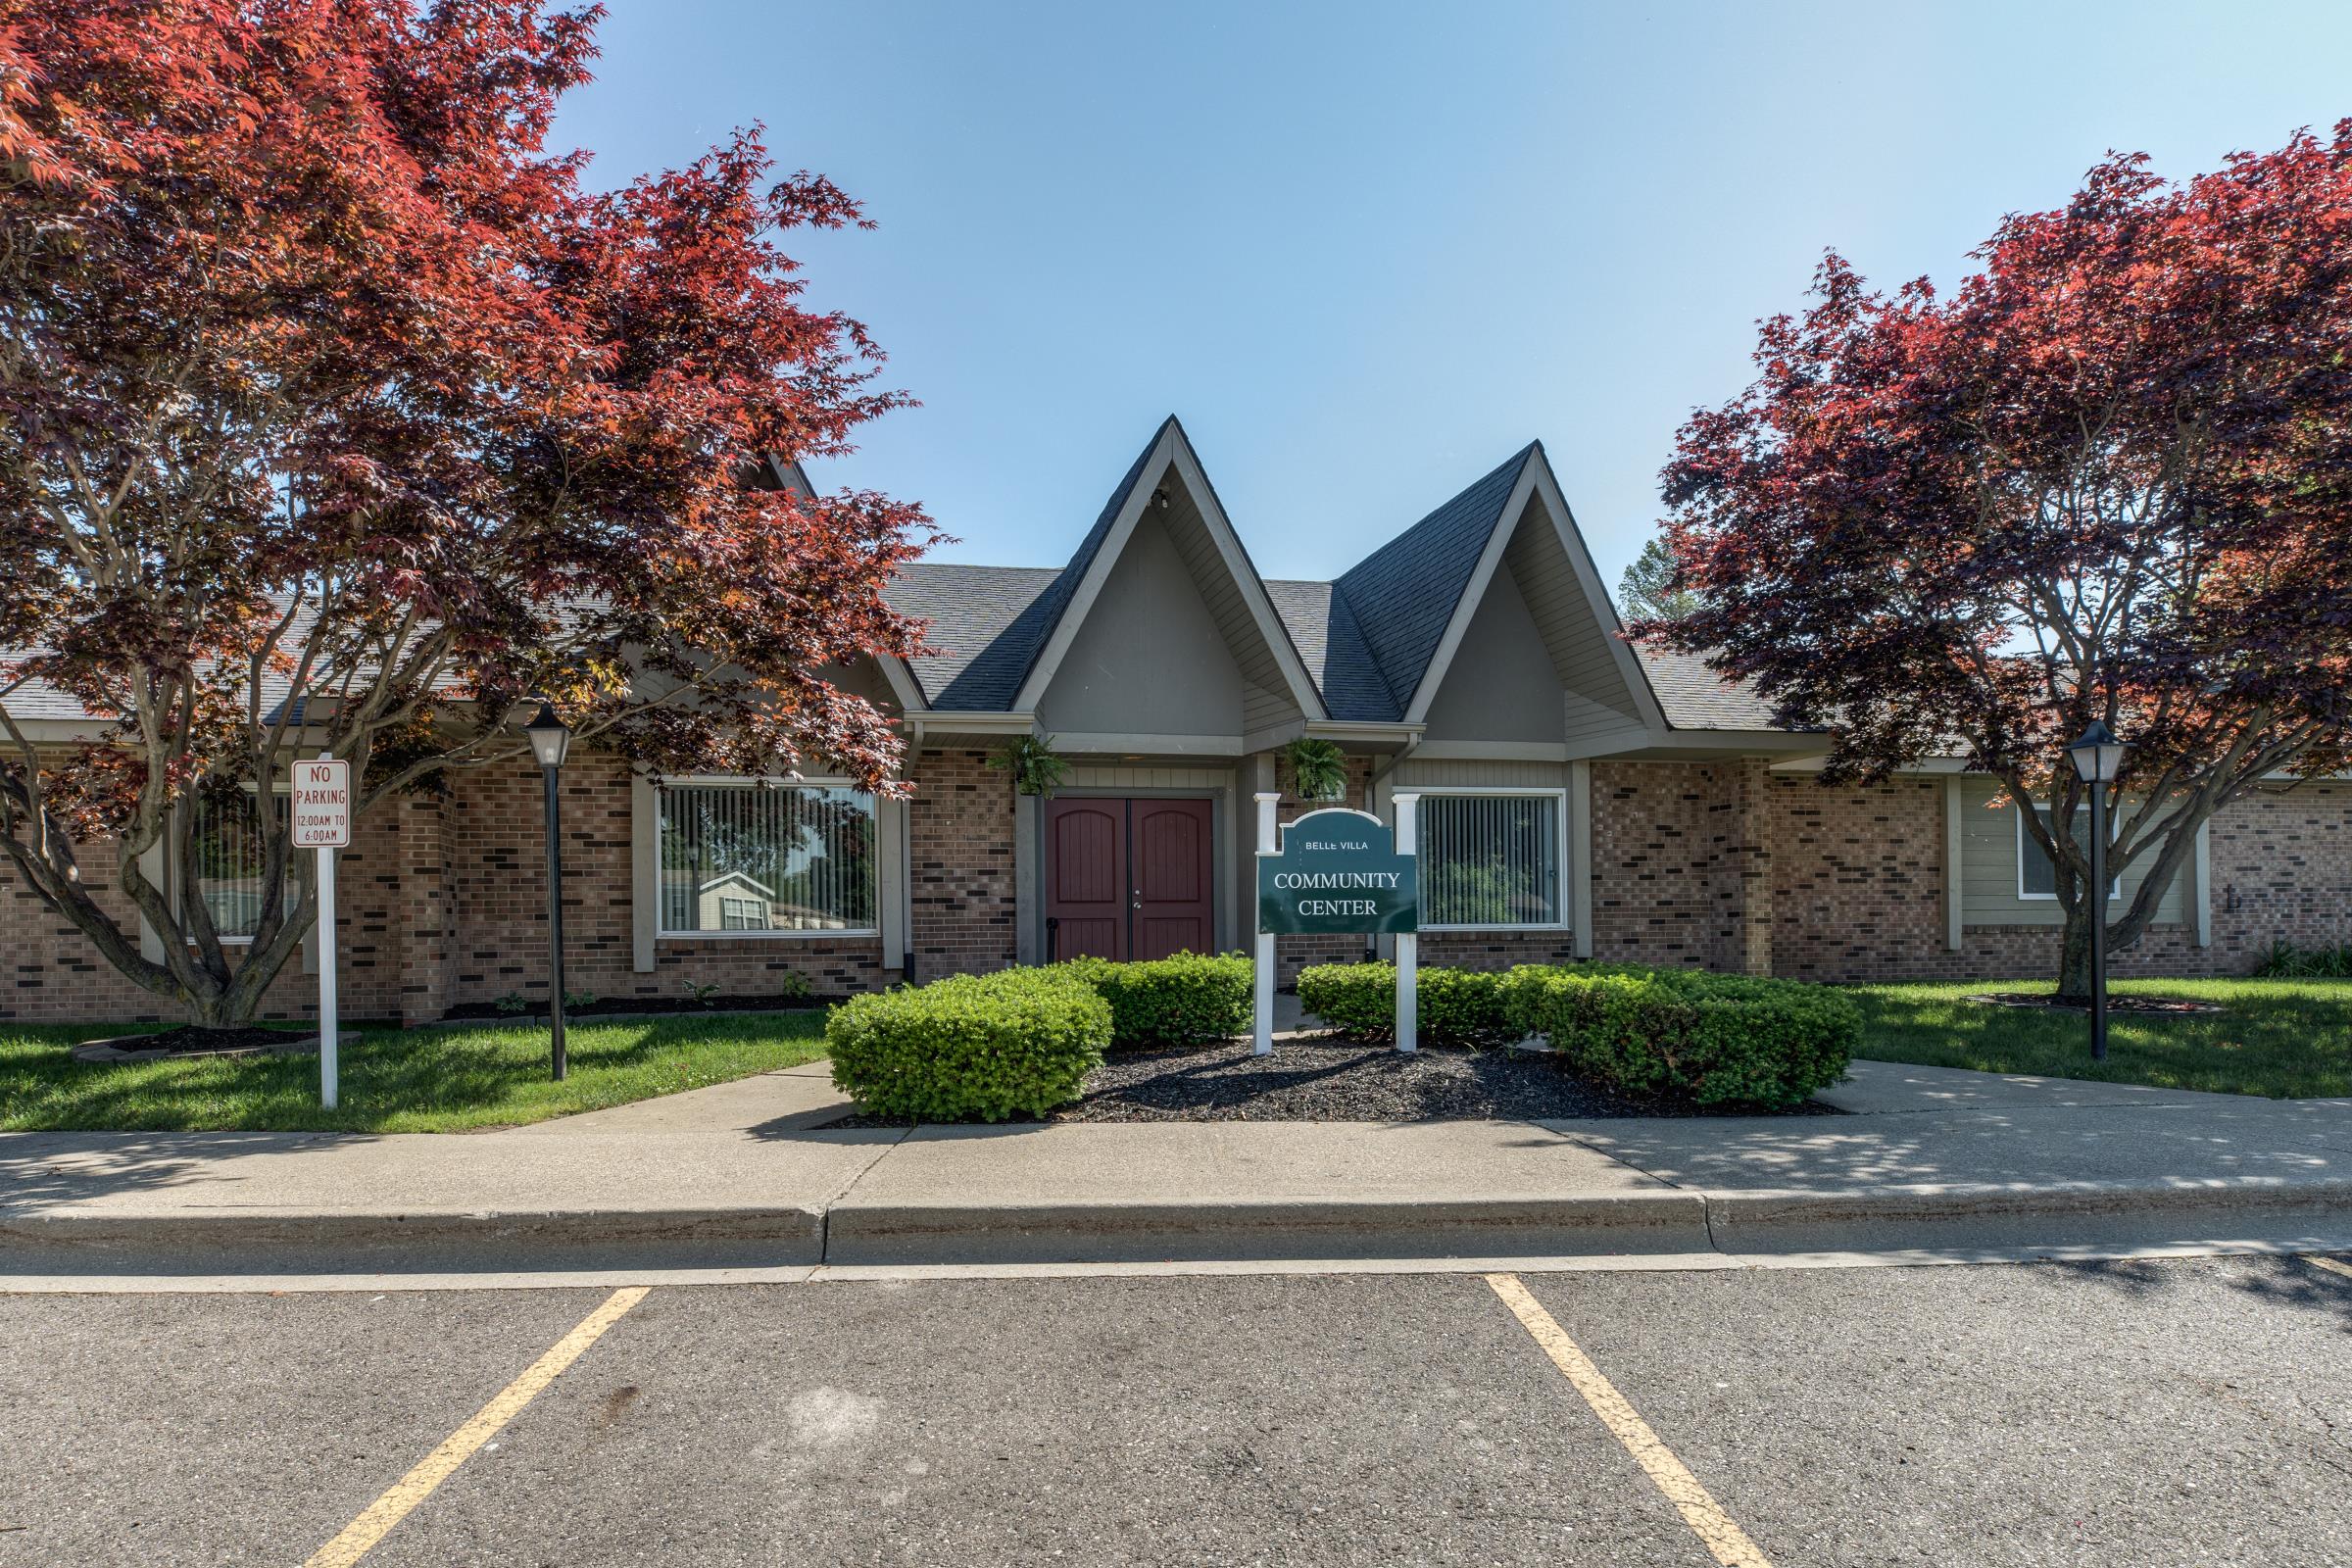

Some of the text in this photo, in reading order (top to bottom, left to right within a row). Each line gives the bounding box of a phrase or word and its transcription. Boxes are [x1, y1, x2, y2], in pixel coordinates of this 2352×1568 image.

[311, 766, 330, 782] NO
[296, 790, 345, 804] PARKING
[297, 815, 345, 826] 12:00AM TO
[305, 830, 337, 841] 6:00AM
[1340, 841, 1368, 850] VILLA
[1274, 873, 1400, 889] COMMUNITY
[1298, 901, 1378, 915] CENTER
